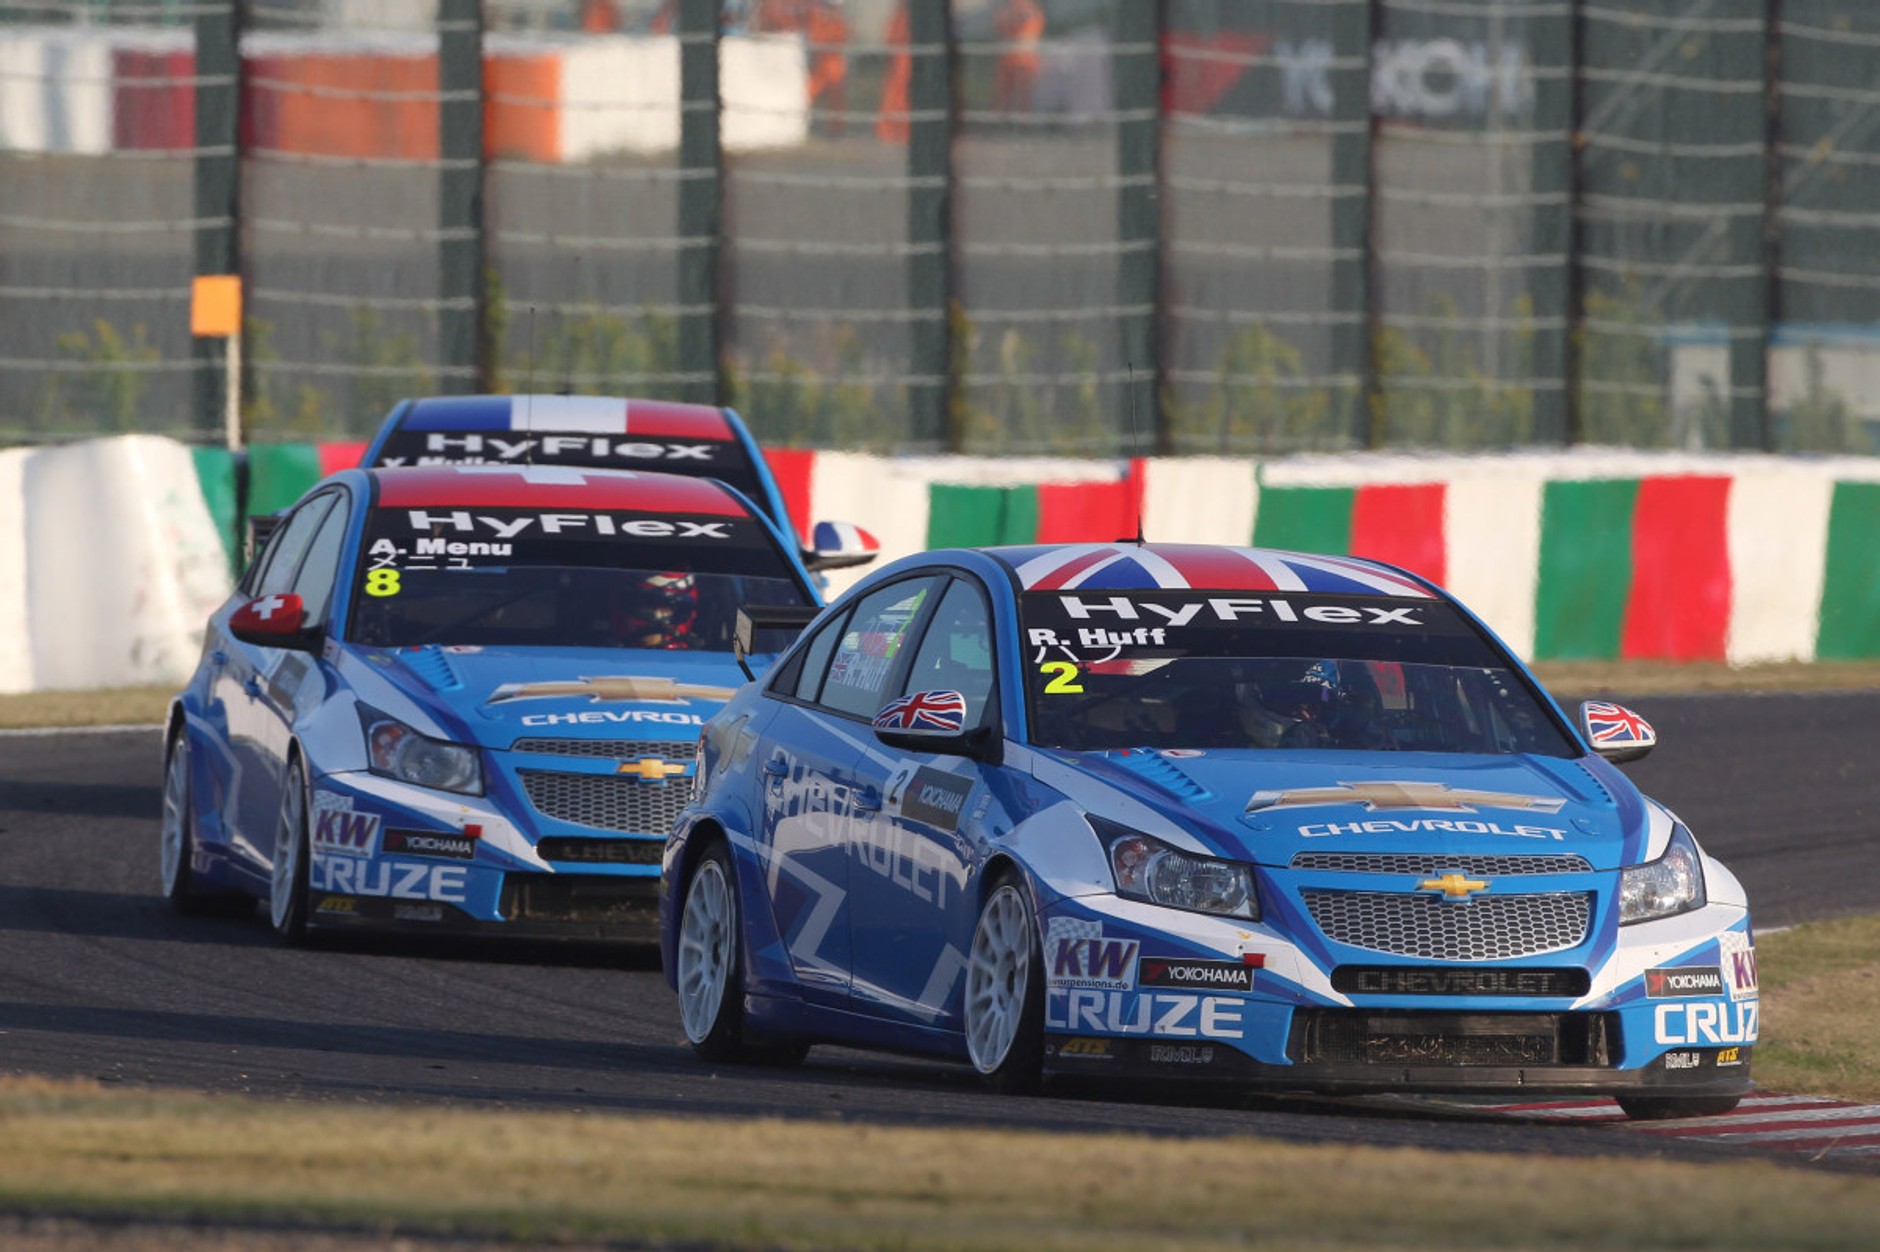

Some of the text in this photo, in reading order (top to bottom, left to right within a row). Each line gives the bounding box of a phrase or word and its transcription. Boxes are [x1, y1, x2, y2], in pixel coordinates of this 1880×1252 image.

[427, 433, 713, 460] HyFlex
[408, 510, 726, 538] HyFlex
[368, 538, 512, 556] A. Menu
[365, 568, 401, 597] 8
[1058, 595, 1424, 627] HyFlex
[1028, 627, 1166, 646] R. Huff
[1039, 660, 1084, 694] 2
[888, 769, 909, 805] 2
[314, 808, 379, 849] KW
[1298, 818, 1568, 841] CHEVROLET
[405, 836, 472, 854] YOKOHAMA
[310, 856, 468, 902] CRUZE
[1053, 938, 1138, 980] KW
[1167, 965, 1248, 984] YOKOHAMA
[1357, 970, 1556, 993] CHEVROLET
[1667, 974, 1721, 990] YOKOHAMA
[1046, 988, 1246, 1038] CRUZE
[1717, 1047, 1739, 1062] ATS
